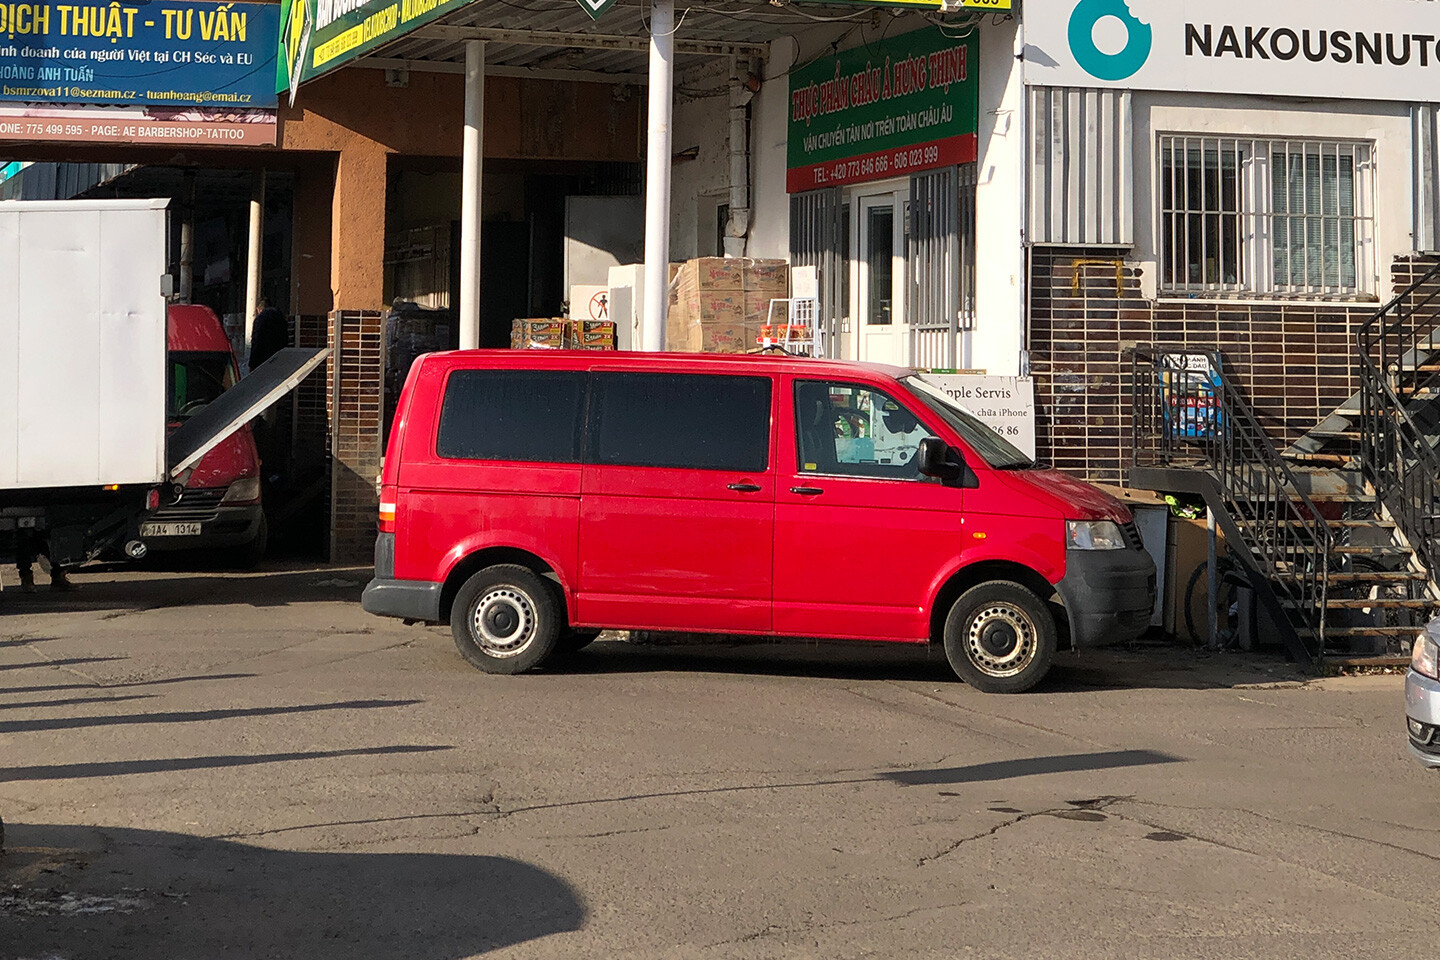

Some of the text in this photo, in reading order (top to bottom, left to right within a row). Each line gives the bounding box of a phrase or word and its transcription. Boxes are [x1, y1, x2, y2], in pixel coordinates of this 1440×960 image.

[57, 1, 138, 43] THUẬT
[161, 8, 194, 40] TƯ
[199, 2, 247, 42] VẤN
[1185, 23, 1440, 68] NAKOUSNUT
[21, 46, 59, 58] doanh
[90, 49, 124, 62] người
[128, 49, 150, 63] Việt
[154, 50, 169, 64] tại
[173, 51, 191, 62] CH
[194, 51, 217, 64] Séc
[220, 53, 233, 64] và
[237, 53, 253, 65] EU
[37, 67, 61, 81] ANH
[893, 43, 968, 97] HƯNG THỊNH
[26, 124, 43, 134] 775
[45, 124, 62, 135] 499
[65, 125, 82, 135] 595
[91, 126, 120, 136] PAGE:
[123, 126, 135, 137] AE
[138, 126, 245, 139] BARBERSHOP-TATTOO
[975, 386, 1011, 399] Servis
[999, 408, 1028, 417] iPhone
[1006, 425, 1019, 435] 86
[175, 524, 197, 534] 1314
